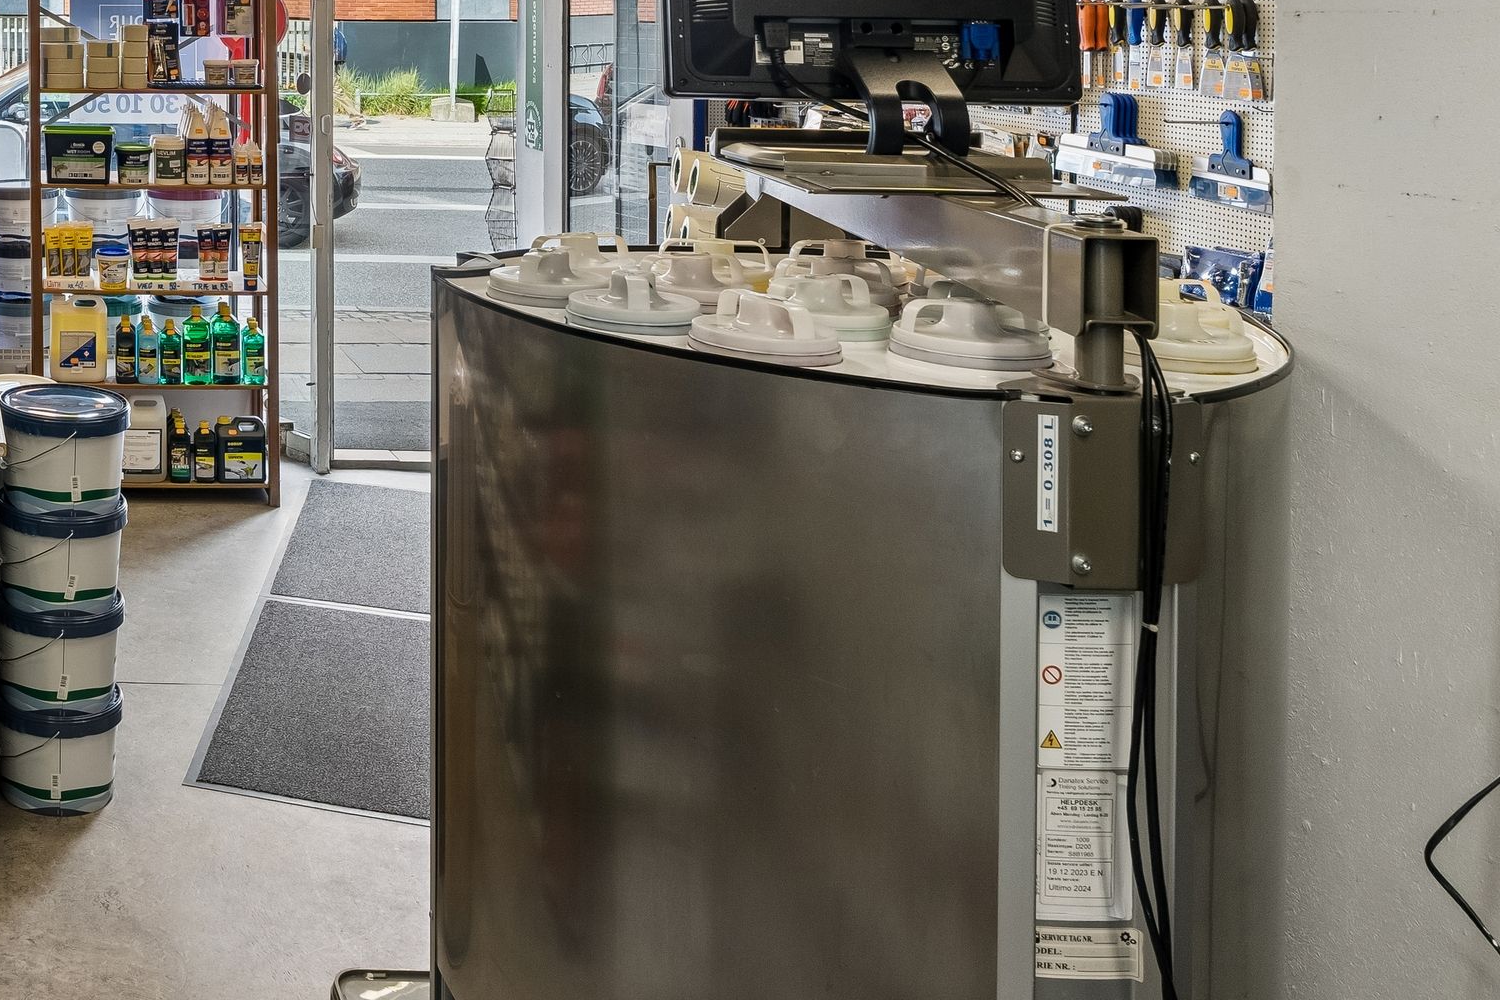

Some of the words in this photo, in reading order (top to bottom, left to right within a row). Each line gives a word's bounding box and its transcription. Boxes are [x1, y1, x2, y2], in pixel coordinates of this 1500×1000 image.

[1044, 417, 1054, 429] L
[1043, 437, 1054, 491] 0.308
[1041, 933, 1068, 942] SERVICE
[1036, 947, 1062, 955] ODEL:
[1037, 961, 1053, 970] RIE
